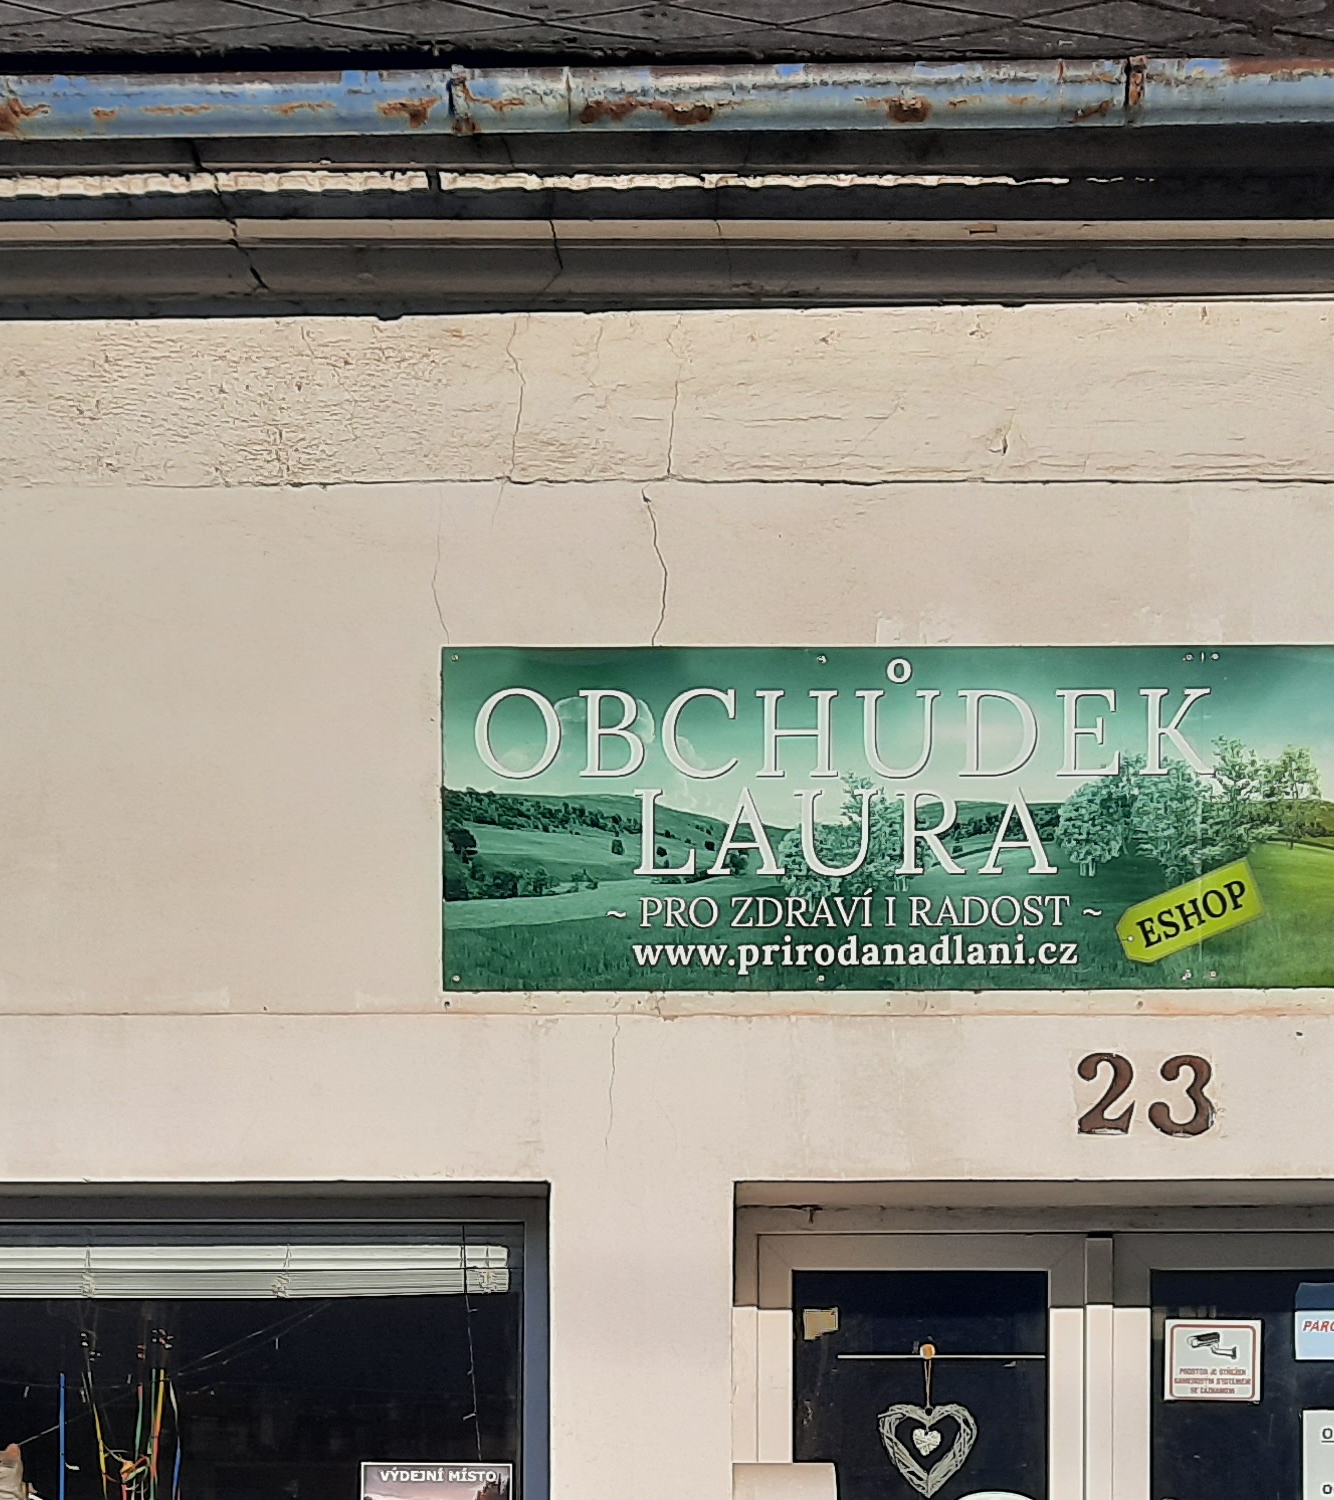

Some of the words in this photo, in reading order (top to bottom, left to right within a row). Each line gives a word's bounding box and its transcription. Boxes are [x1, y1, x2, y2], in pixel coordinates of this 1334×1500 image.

[474, 657, 1217, 779] OBCHŮDEK
[633, 787, 1058, 876] LAURA
[641, 896, 718, 928] PRO
[731, 889, 872, 928] ZDRAVÍ
[886, 897, 895, 928] I
[910, 896, 1070, 928] RADOST
[1136, 880, 1245, 948] ESHOP
[633, 934, 1078, 974] www.prirodanadlani.cz
[1075, 1051, 1216, 1137] 23
[380, 1467, 444, 1481] VÝDEJNÍ
[449, 1468, 496, 1482] MÍSTO
